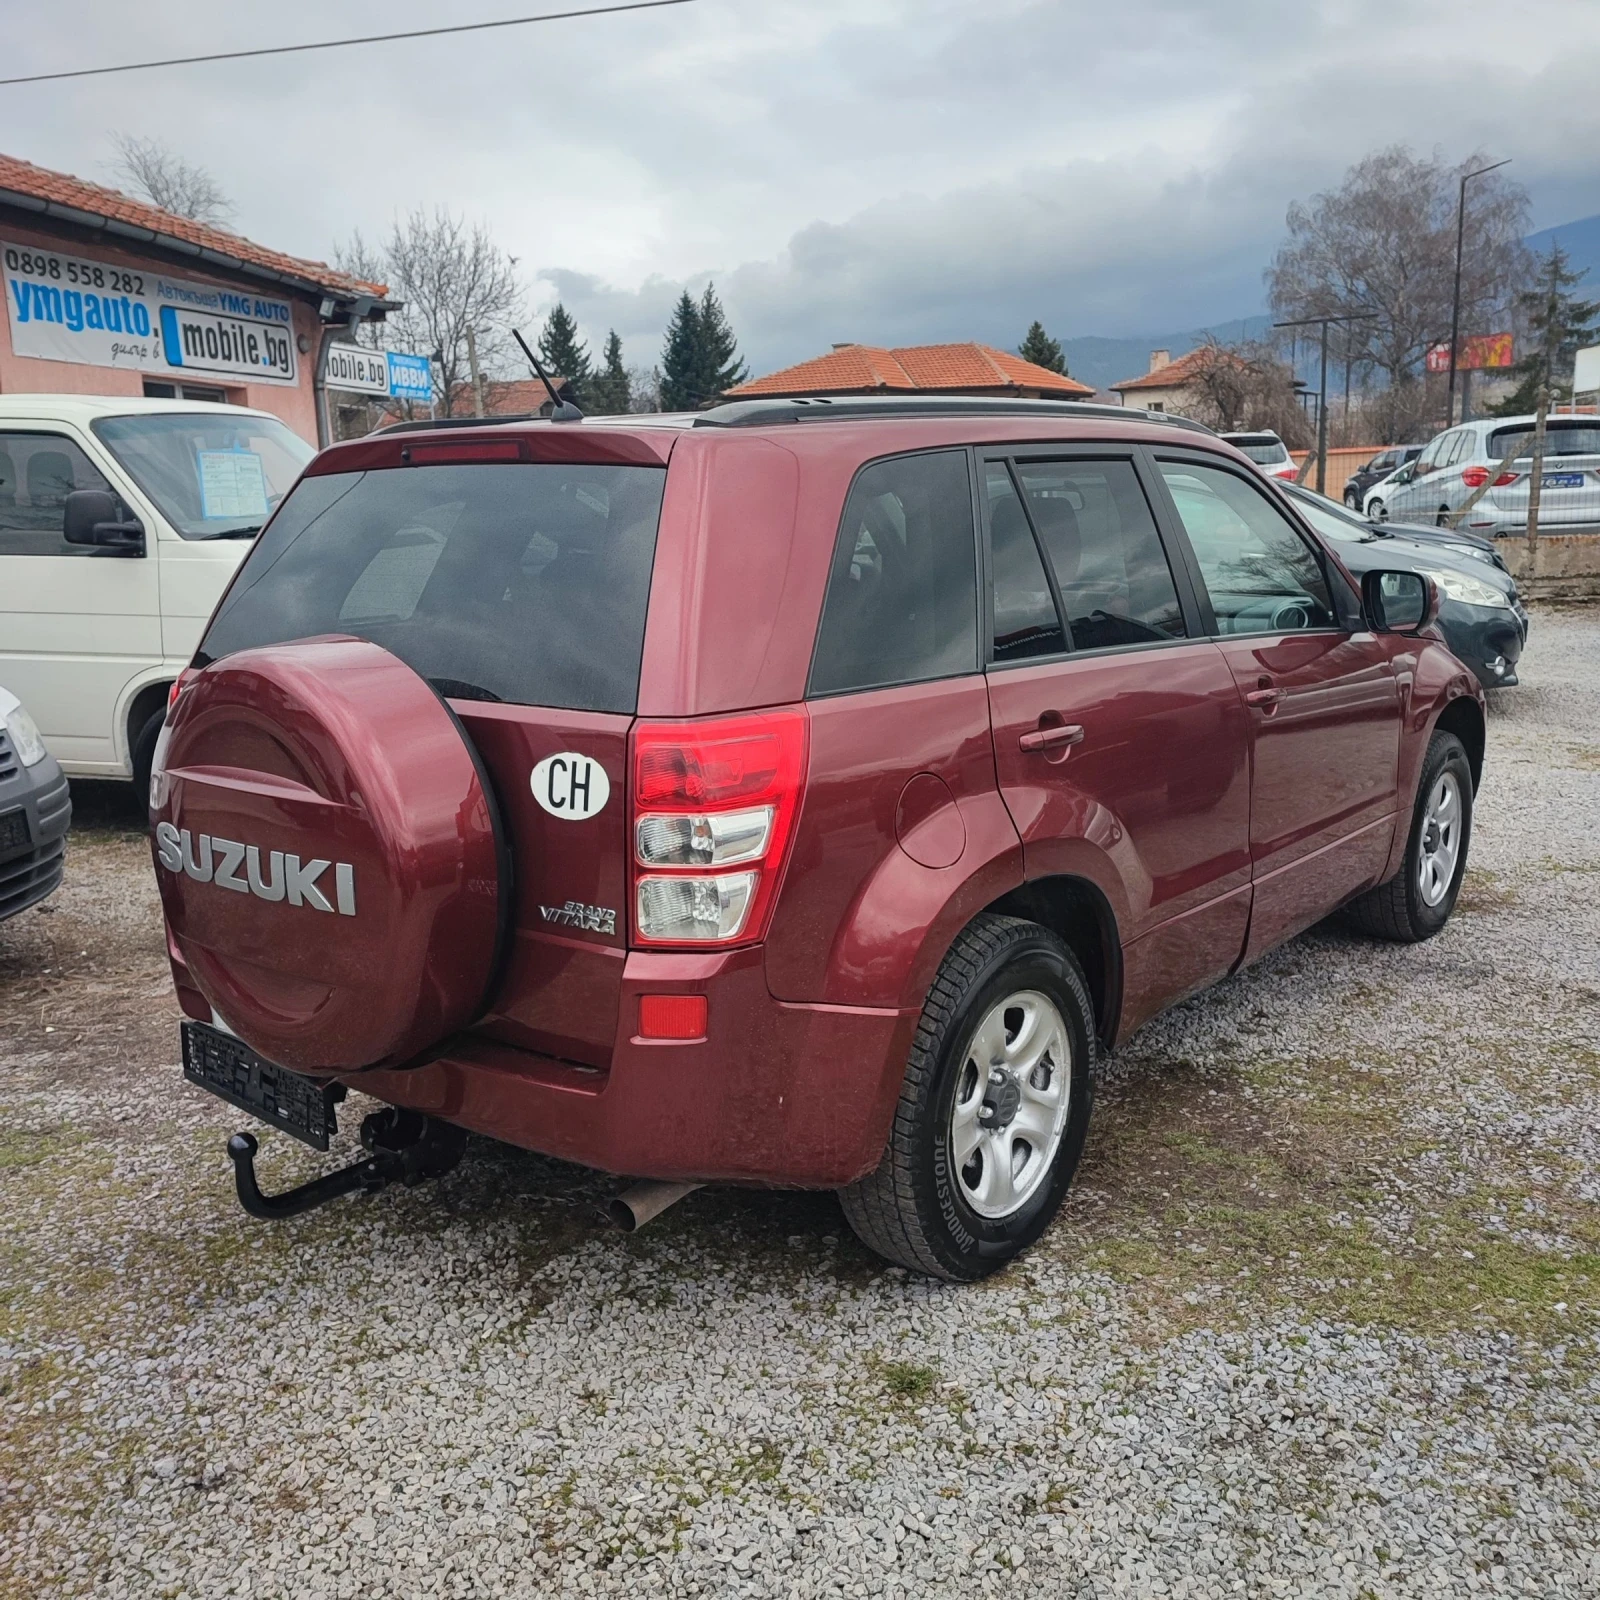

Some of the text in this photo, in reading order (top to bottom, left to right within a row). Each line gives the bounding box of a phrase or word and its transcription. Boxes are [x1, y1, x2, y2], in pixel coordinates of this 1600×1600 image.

[5, 249, 146, 297] 0898 558 282
[217, 292, 290, 322] YMG AUTO
[182, 321, 290, 374] mobile.bg
[547, 758, 592, 812] CH
[156, 821, 357, 917] SUZUKI
[538, 905, 616, 936] VITARA
[564, 901, 616, 920] GRAND
[1065, 967, 1096, 1080] BRIDGESTONE
[934, 1134, 976, 1254] BRIDGESTONE
